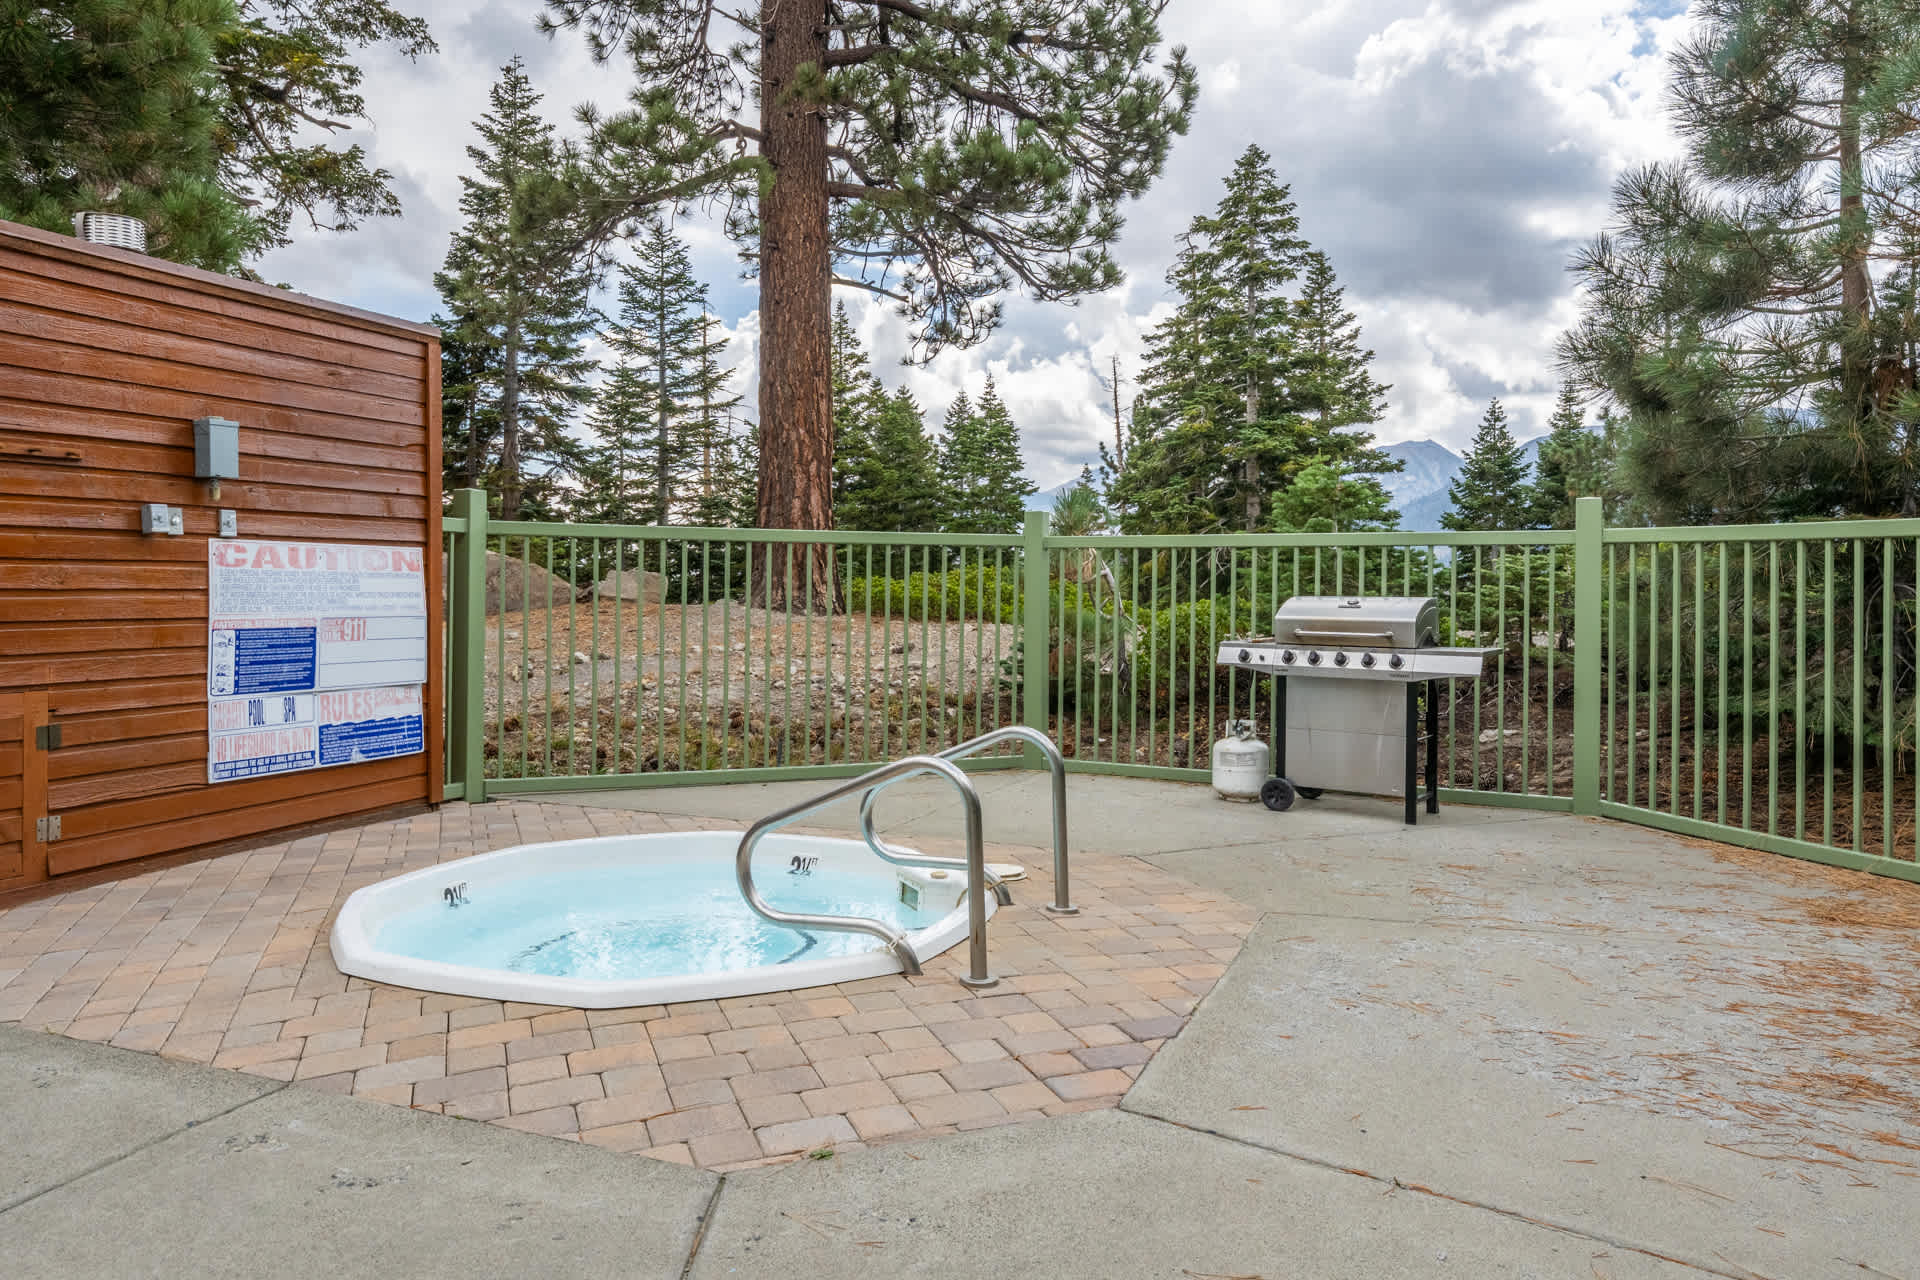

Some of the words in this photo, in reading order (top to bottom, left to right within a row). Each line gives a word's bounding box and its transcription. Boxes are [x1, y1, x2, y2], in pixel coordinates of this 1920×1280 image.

[215, 543, 421, 572] CAUTION
[248, 698, 265, 726] POOL
[283, 696, 296, 723] SPA
[320, 691, 373, 721] RULES
[215, 736, 227, 762] NO
